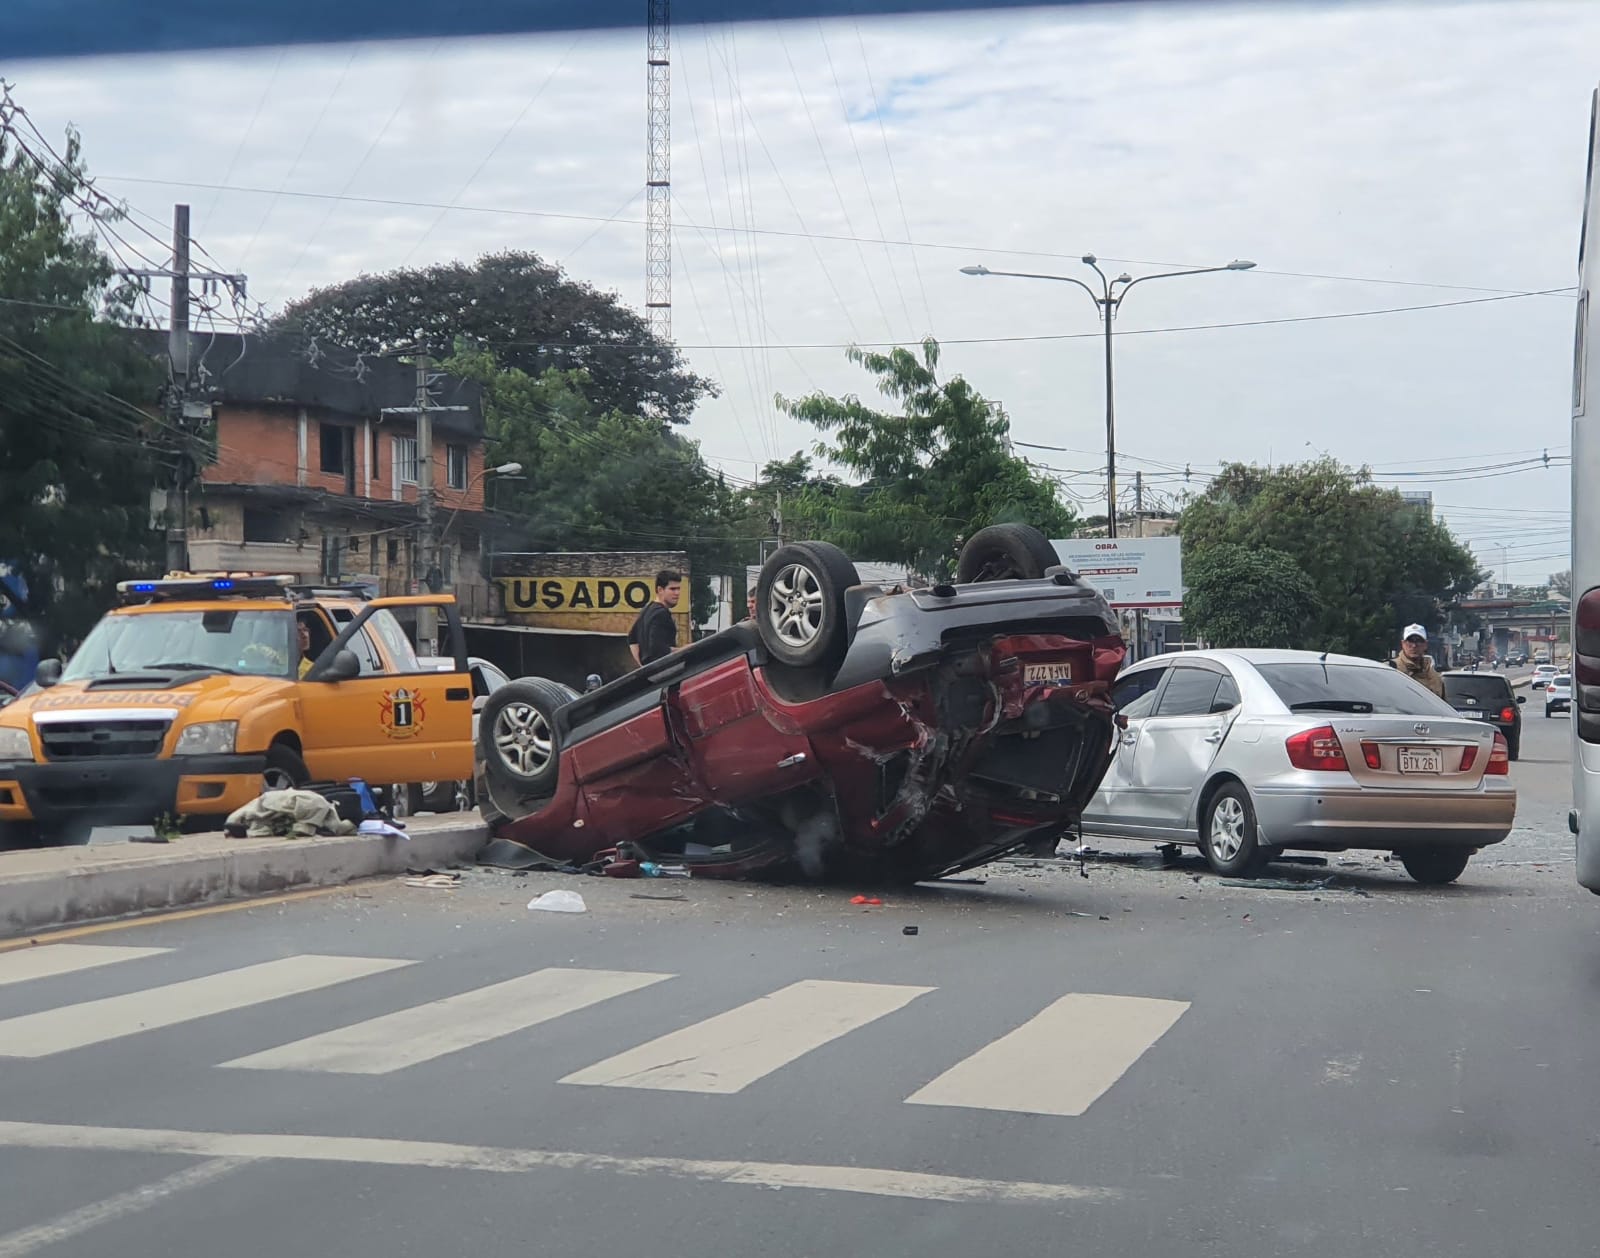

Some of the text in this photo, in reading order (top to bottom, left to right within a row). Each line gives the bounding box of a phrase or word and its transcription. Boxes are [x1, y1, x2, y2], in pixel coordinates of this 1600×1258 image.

[398, 703, 407, 725] 1
[1403, 758, 1439, 770] BTX 261
